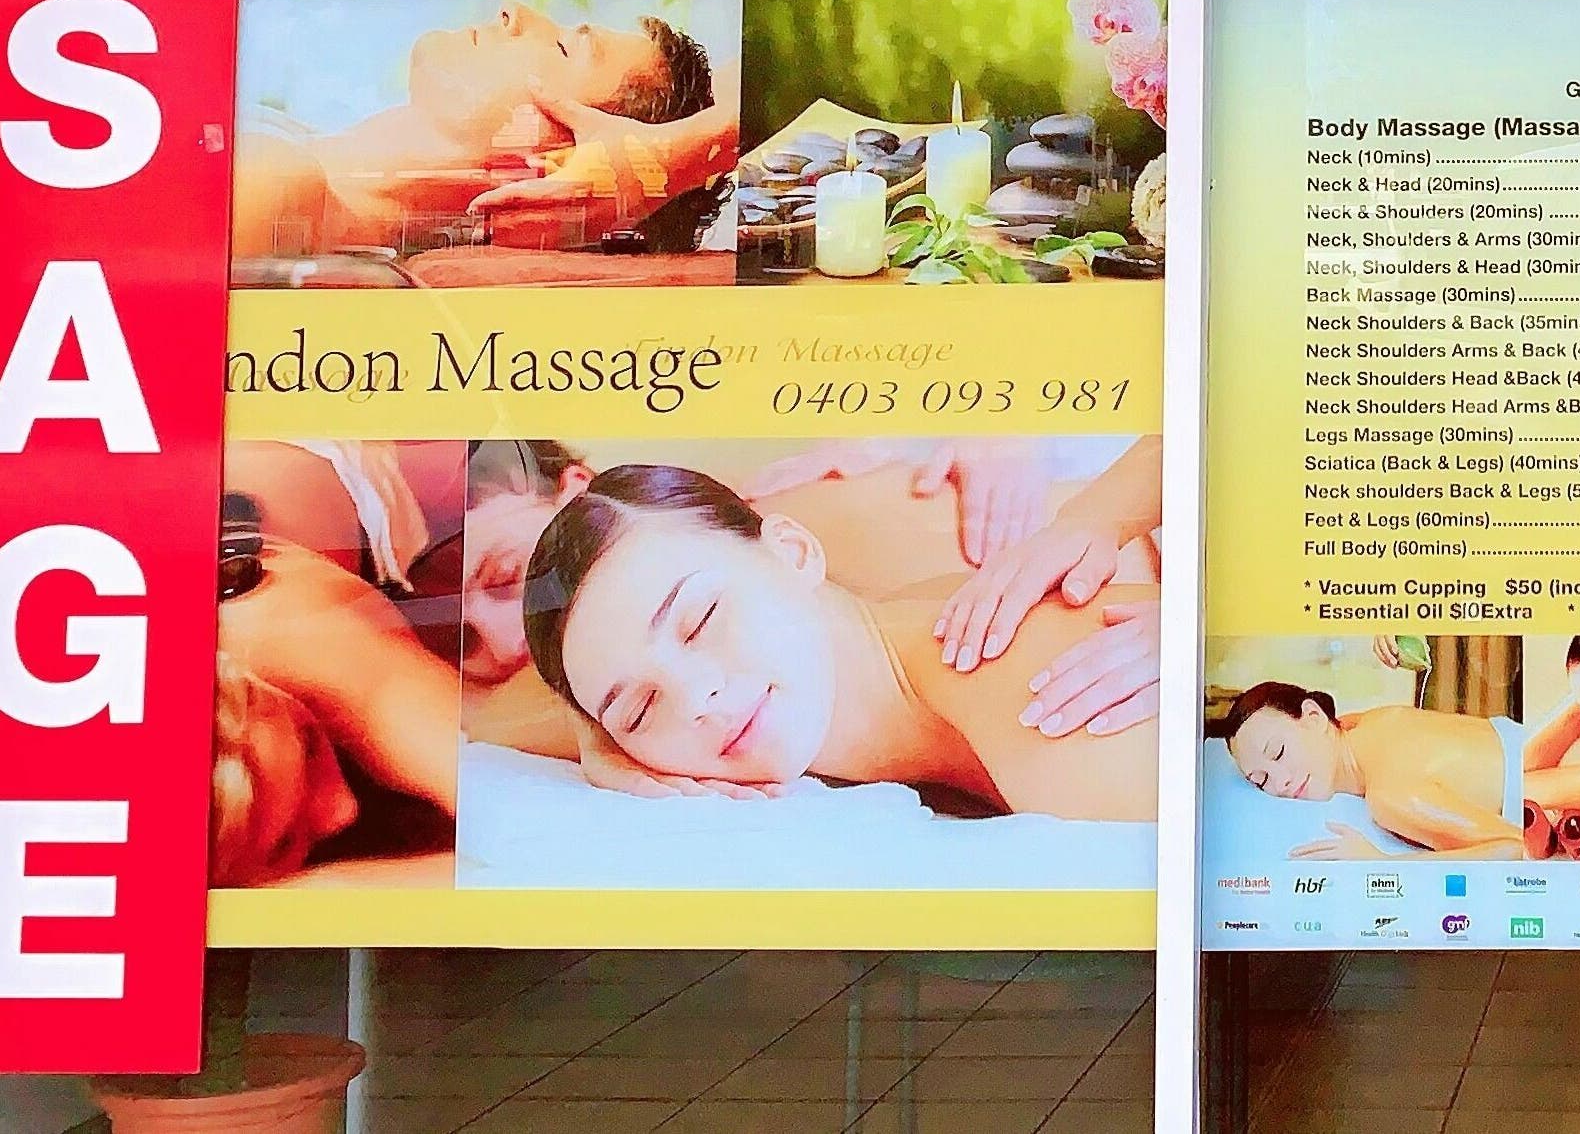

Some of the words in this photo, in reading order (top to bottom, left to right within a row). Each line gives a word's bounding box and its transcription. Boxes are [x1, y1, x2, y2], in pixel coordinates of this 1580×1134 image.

[1307, 117, 1369, 142] Body
[1376, 117, 1486, 141] Massage
[1307, 149, 1353, 165] Neck
[1357, 148, 1431, 168] (10mins)
[1306, 232, 1357, 250] Neck,
[1362, 231, 1452, 247] Shoulders
[1474, 231, 1522, 247] Arms
[426, 331, 722, 413] Massage
[772, 380, 898, 415] 0403
[921, 379, 1015, 413] 093
[1037, 378, 1131, 412] 981
[1304, 454, 1376, 472] Sciatica
[1381, 454, 1433, 474] (Back
[1455, 454, 1504, 474] Legs)
[1318, 579, 1397, 596] Vacuum
[1403, 578, 1487, 599] Cupping
[1504, 577, 1543, 597] $50
[1318, 602, 1409, 620] Essential
[1416, 602, 1443, 620] Oil
[1294, 877, 1326, 894] hbf
